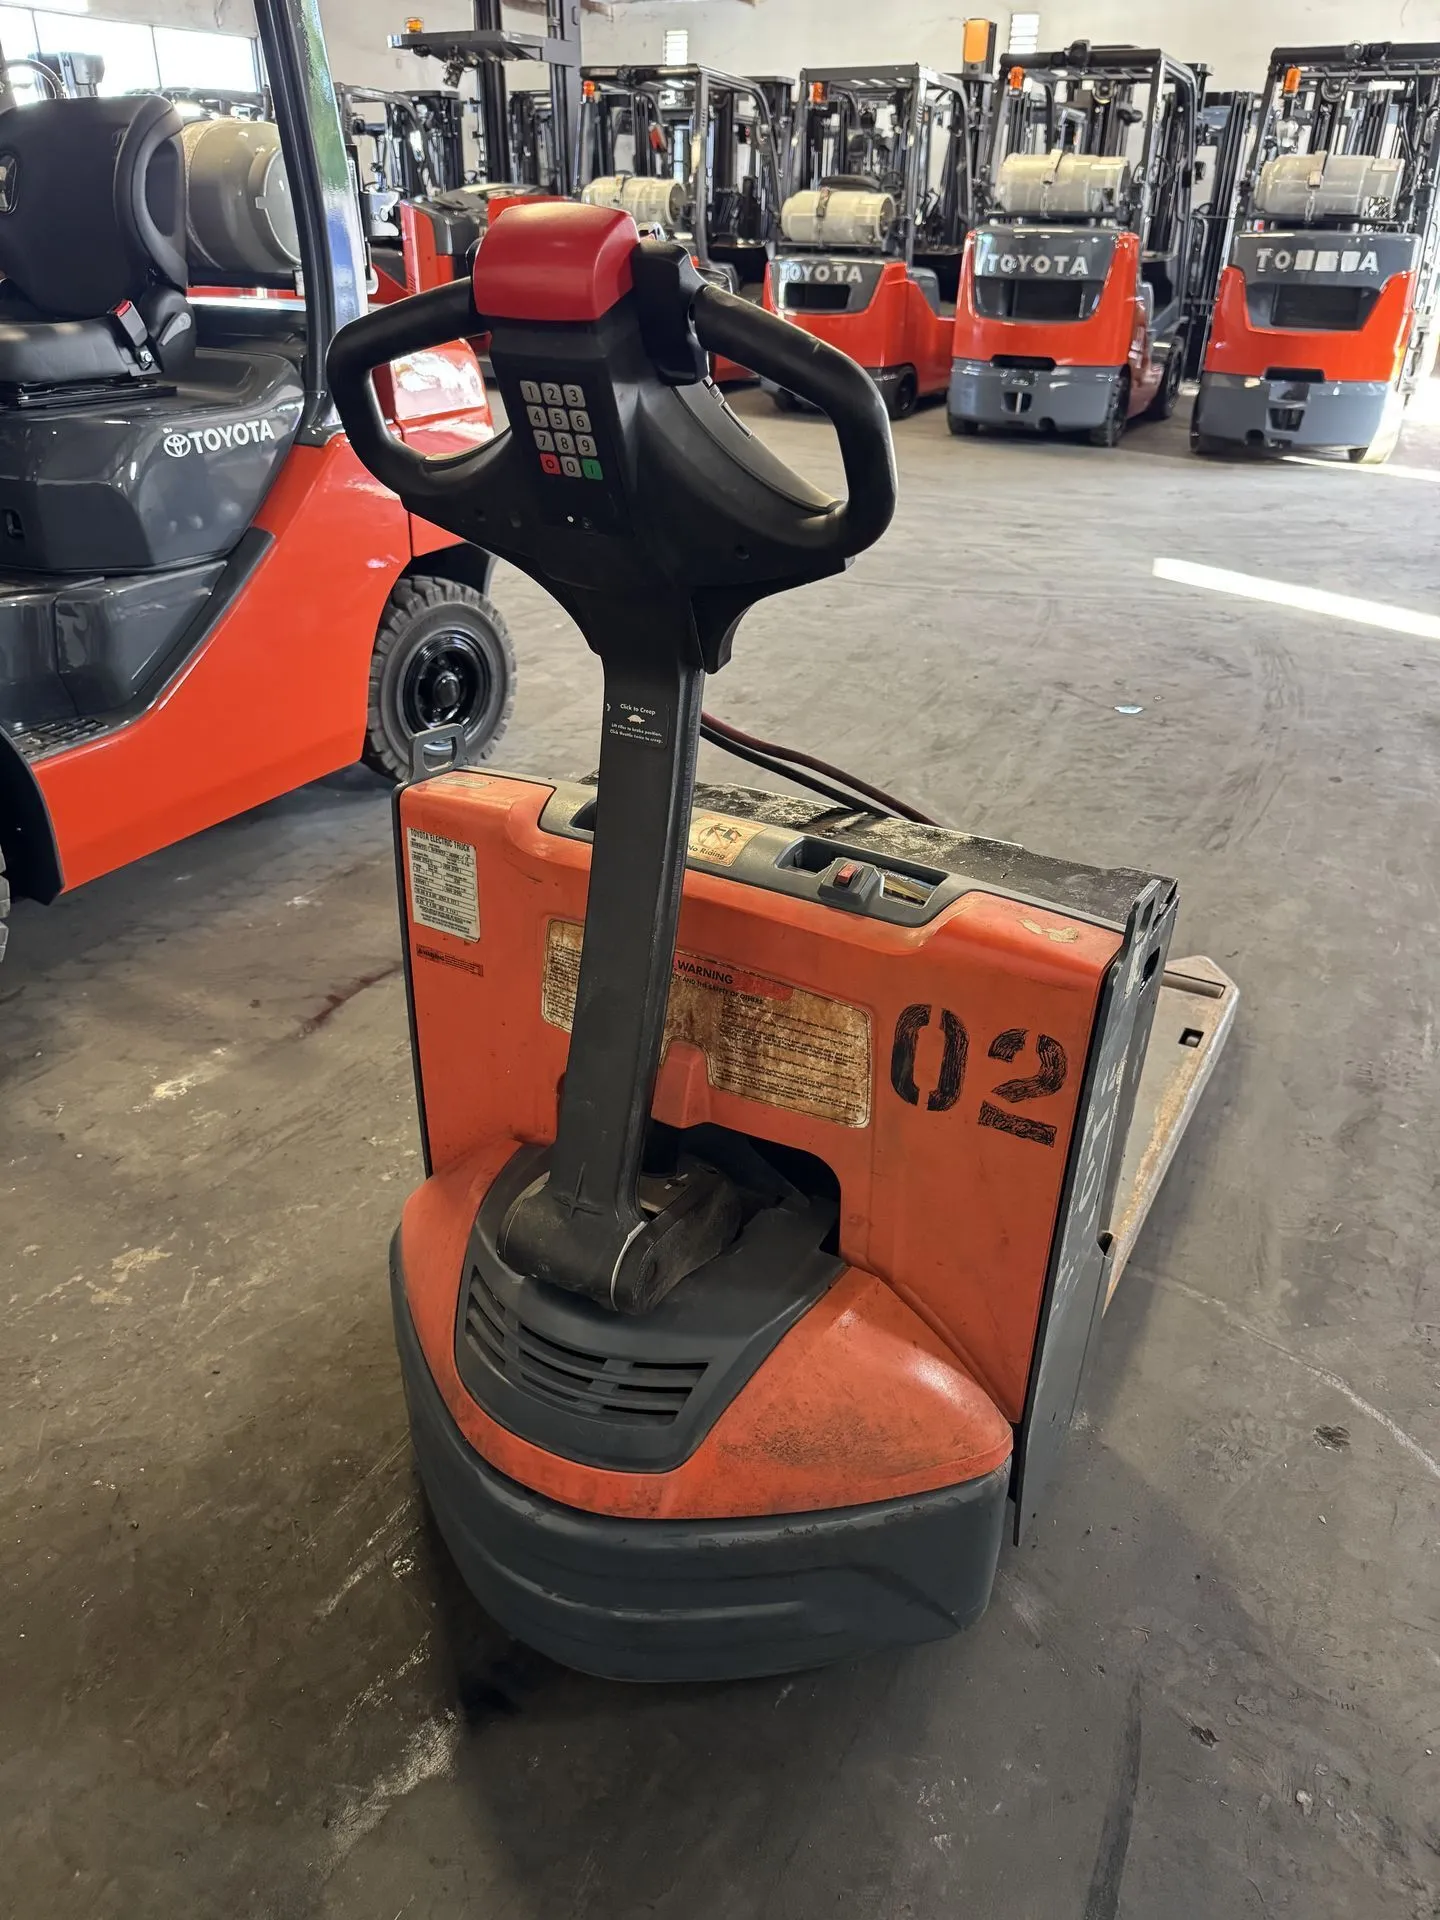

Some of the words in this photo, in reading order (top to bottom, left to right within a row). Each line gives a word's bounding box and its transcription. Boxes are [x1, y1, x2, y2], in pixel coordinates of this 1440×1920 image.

[779, 263, 863, 284] TOYOTA
[987, 253, 1089, 276] TOYOTA
[528, 386, 535, 399] 1
[547, 388, 557, 401] 2
[570, 390, 579, 403] 3
[533, 411, 542, 423] 4
[554, 413, 563, 426] 5
[576, 415, 585, 428] 6
[187, 419, 275, 454] TOYOTA
[539, 435, 546, 447] 7
[560, 437, 568, 449] 8
[581, 439, 590, 452] 9
[640, 707, 656, 715] Creep
[410, 828, 429, 842] TOYOTA
[430, 834, 453, 848] ELECTRIC
[454, 840, 471, 852] TRUCK
[699, 847, 726, 860] Riding
[677, 960, 734, 984] WARNING
[682, 976, 696, 985] AND
[697, 980, 707, 988] THE
[708, 984, 729, 995] SAFETY
[730, 989, 739, 997] OF
[739, 993, 764, 1005] OTHERS
[891, 1003, 1069, 1148] 02
